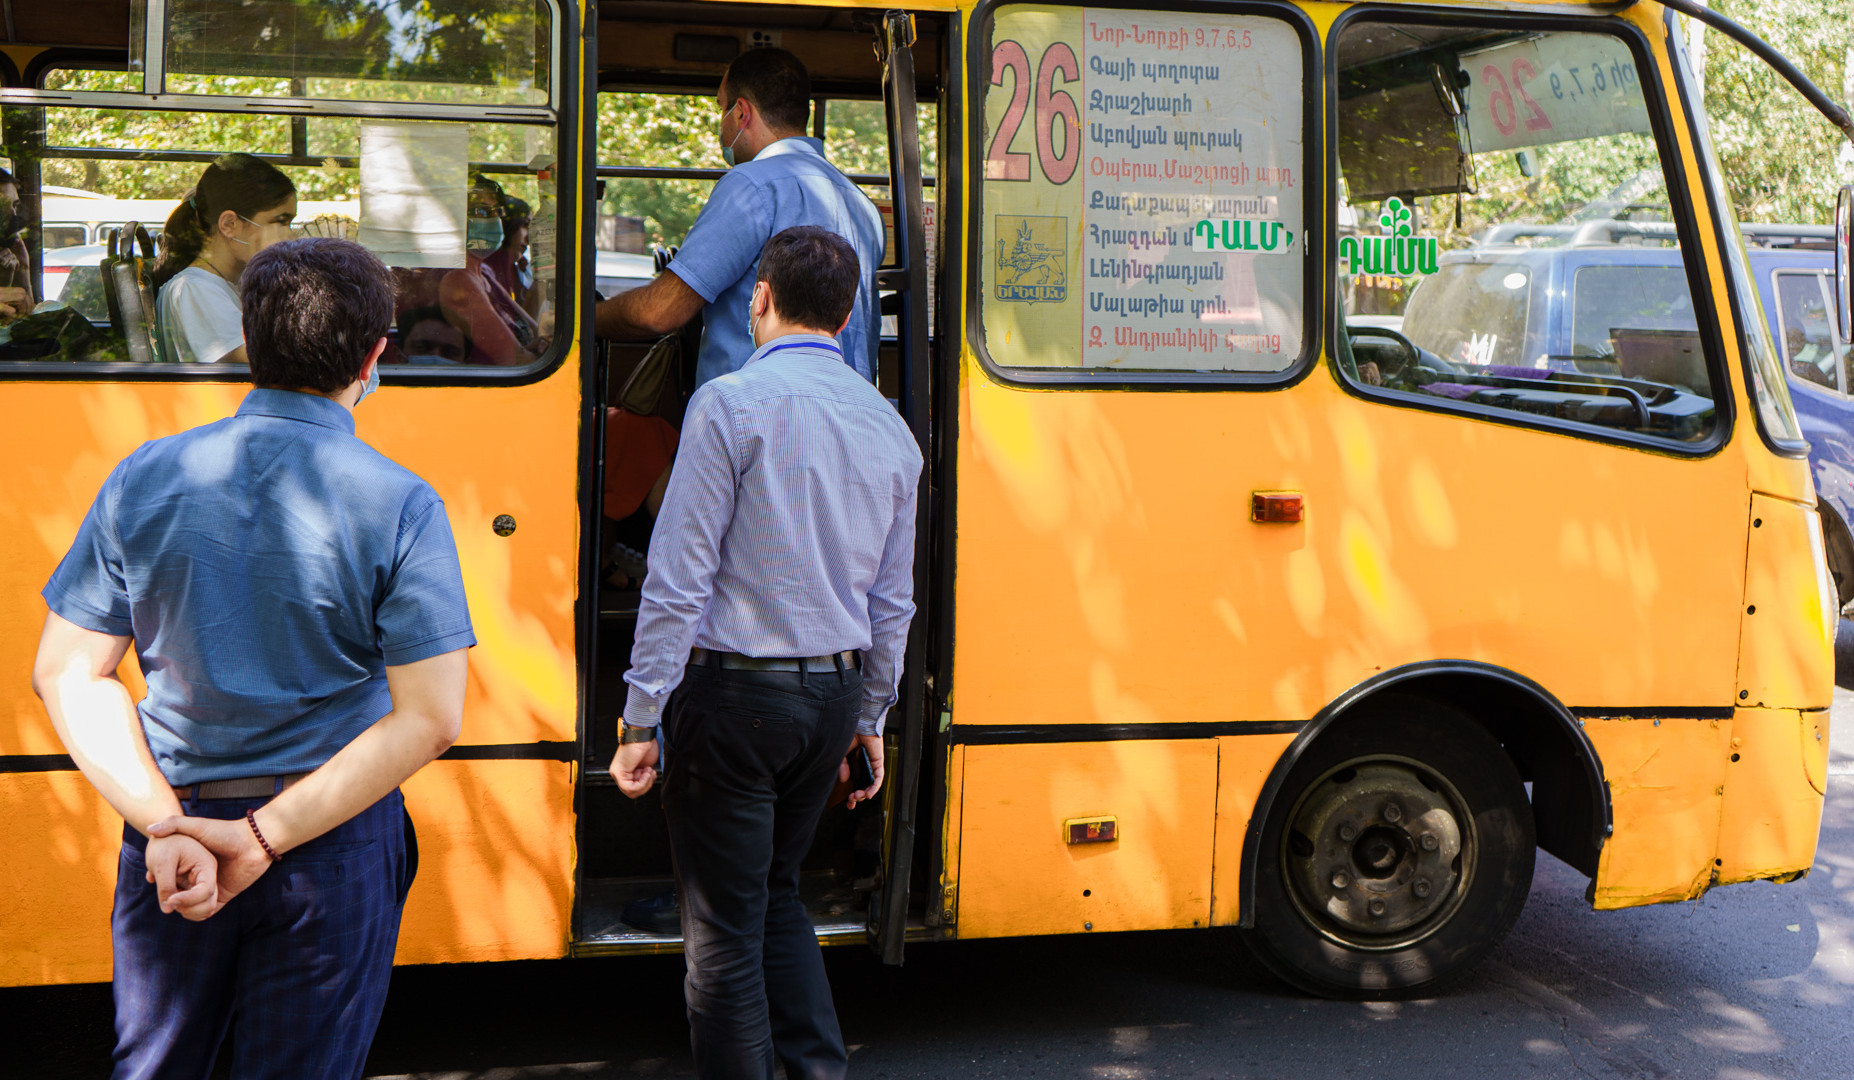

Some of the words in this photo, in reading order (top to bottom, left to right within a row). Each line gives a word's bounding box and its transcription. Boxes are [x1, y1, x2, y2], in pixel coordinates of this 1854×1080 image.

[1090, 22, 1189, 51] Նոր-Նորքի
[1195, 28, 1253, 52] 9,7,6,5
[1090, 56, 1136, 82] Գայի
[1142, 62, 1220, 85] պողոտա
[984, 39, 1081, 186] 26
[1089, 89, 1192, 116] Ջրաշխարհ
[1091, 122, 1168, 149] Աբովյան
[1174, 128, 1243, 152] պուրակ
[1256, 166, 1296, 188] պող.
[1090, 223, 1177, 249] Հրազդան
[1340, 237, 1440, 275] ԴԱԼՄԱ
[1090, 258, 1224, 285] Լենինգրադյան
[1090, 292, 1185, 318] Մալաթիա
[1190, 295, 1232, 319] տոն.
[1114, 326, 1218, 352] Անդրանիկի
